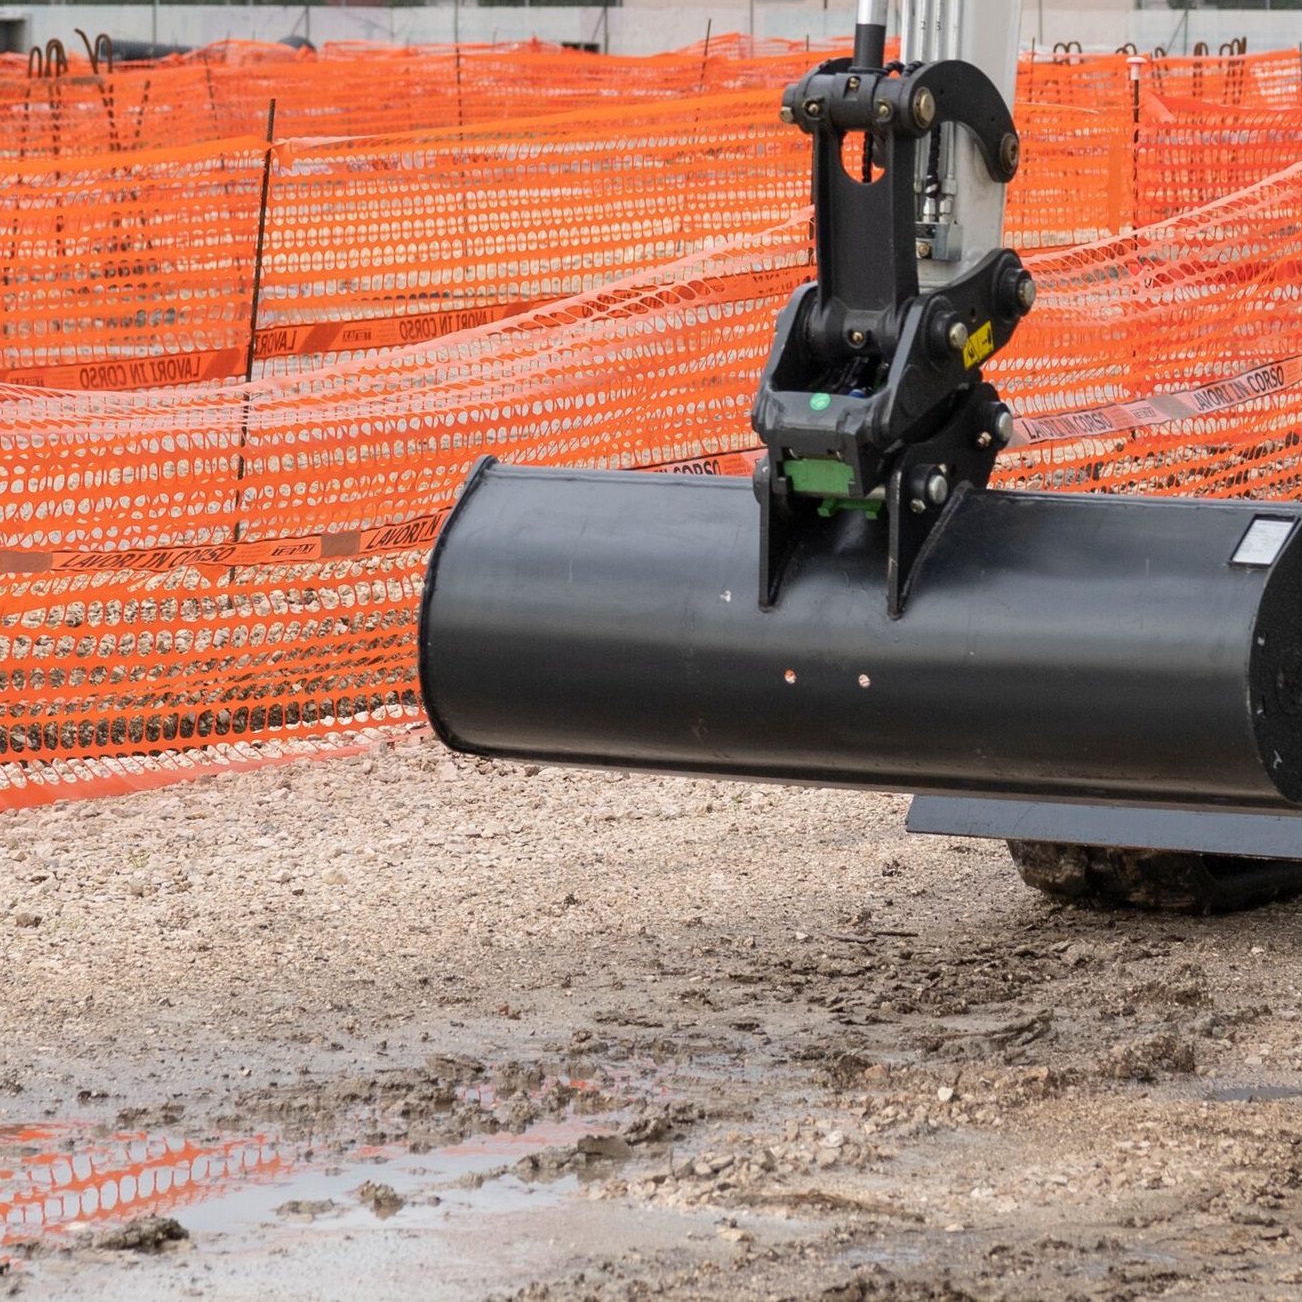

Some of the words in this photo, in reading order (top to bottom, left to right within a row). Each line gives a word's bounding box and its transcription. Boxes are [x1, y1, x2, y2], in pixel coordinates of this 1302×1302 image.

[1194, 384, 1234, 411] AVORI
[1229, 380, 1251, 400] IN
[1246, 365, 1285, 394] CORSO
[1072, 412, 1112, 433] CORSO
[59, 554, 146, 568] LAVORI
[138, 551, 174, 568] IN
